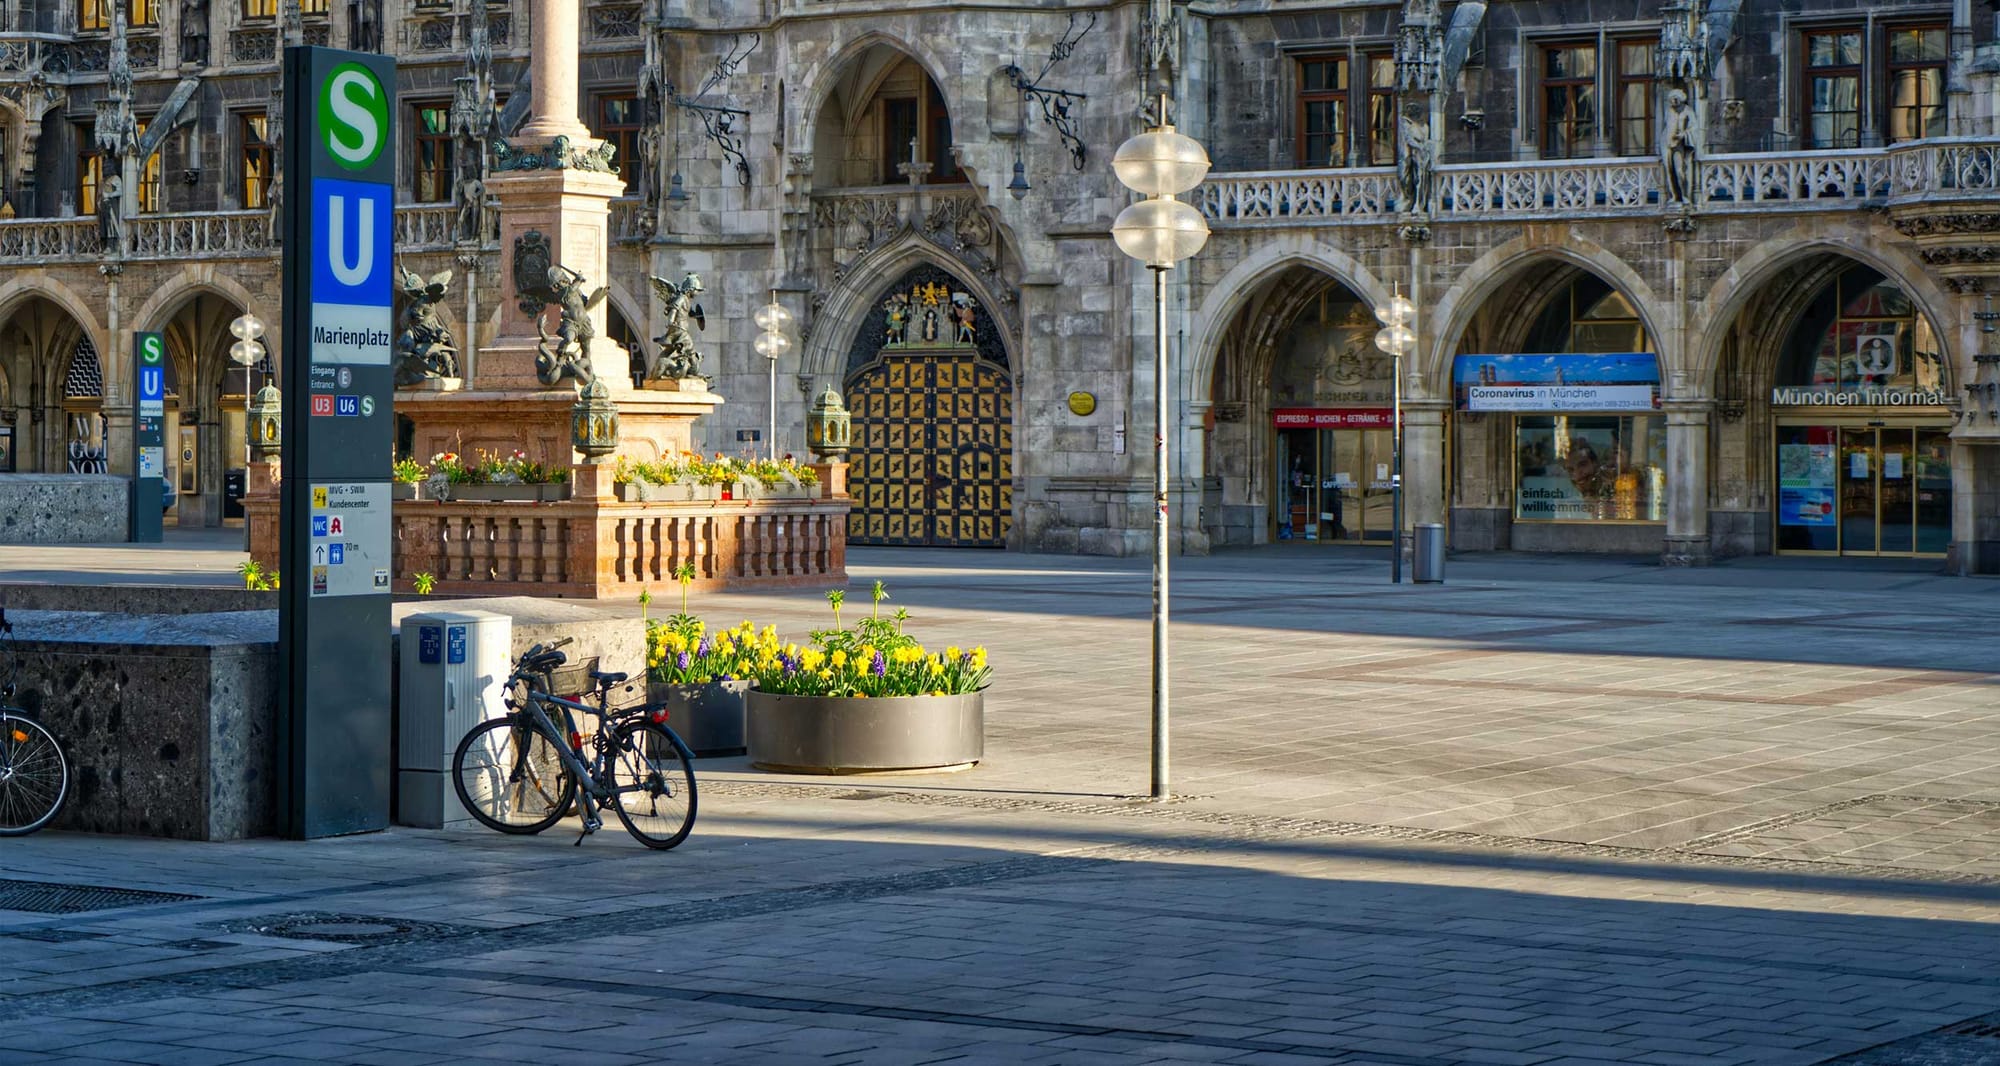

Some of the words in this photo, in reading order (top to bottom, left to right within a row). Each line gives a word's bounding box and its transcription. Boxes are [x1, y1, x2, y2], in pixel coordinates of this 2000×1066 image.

[330, 70, 378, 162] S
[328, 195, 374, 286] U
[313, 326, 389, 349] Marienplatz
[144, 336, 159, 362] S
[311, 366, 335, 377] Eingang
[144, 370, 158, 396] U
[342, 371, 348, 384] E
[311, 380, 335, 389] Entrance
[1471, 388, 1535, 398] Coronavirus
[1537, 388, 1546, 398] in
[1549, 387, 1597, 398] München
[1772, 388, 1859, 405] München
[315, 398, 330, 412] U3
[340, 399, 355, 413] U6
[362, 397, 373, 414] S
[1277, 415, 1309, 423] ESPRESSO
[1315, 415, 1341, 423] KUCHEN
[1347, 413, 1380, 423] GETRÄNKE
[329, 486, 343, 495] MVG
[350, 486, 365, 495] SWM
[1522, 488, 1564, 499] einfach
[329, 500, 370, 508] Kundencenter
[1522, 502, 1595, 512] willkommen
[314, 520, 326, 531] WC
[345, 543, 352, 551] 70
